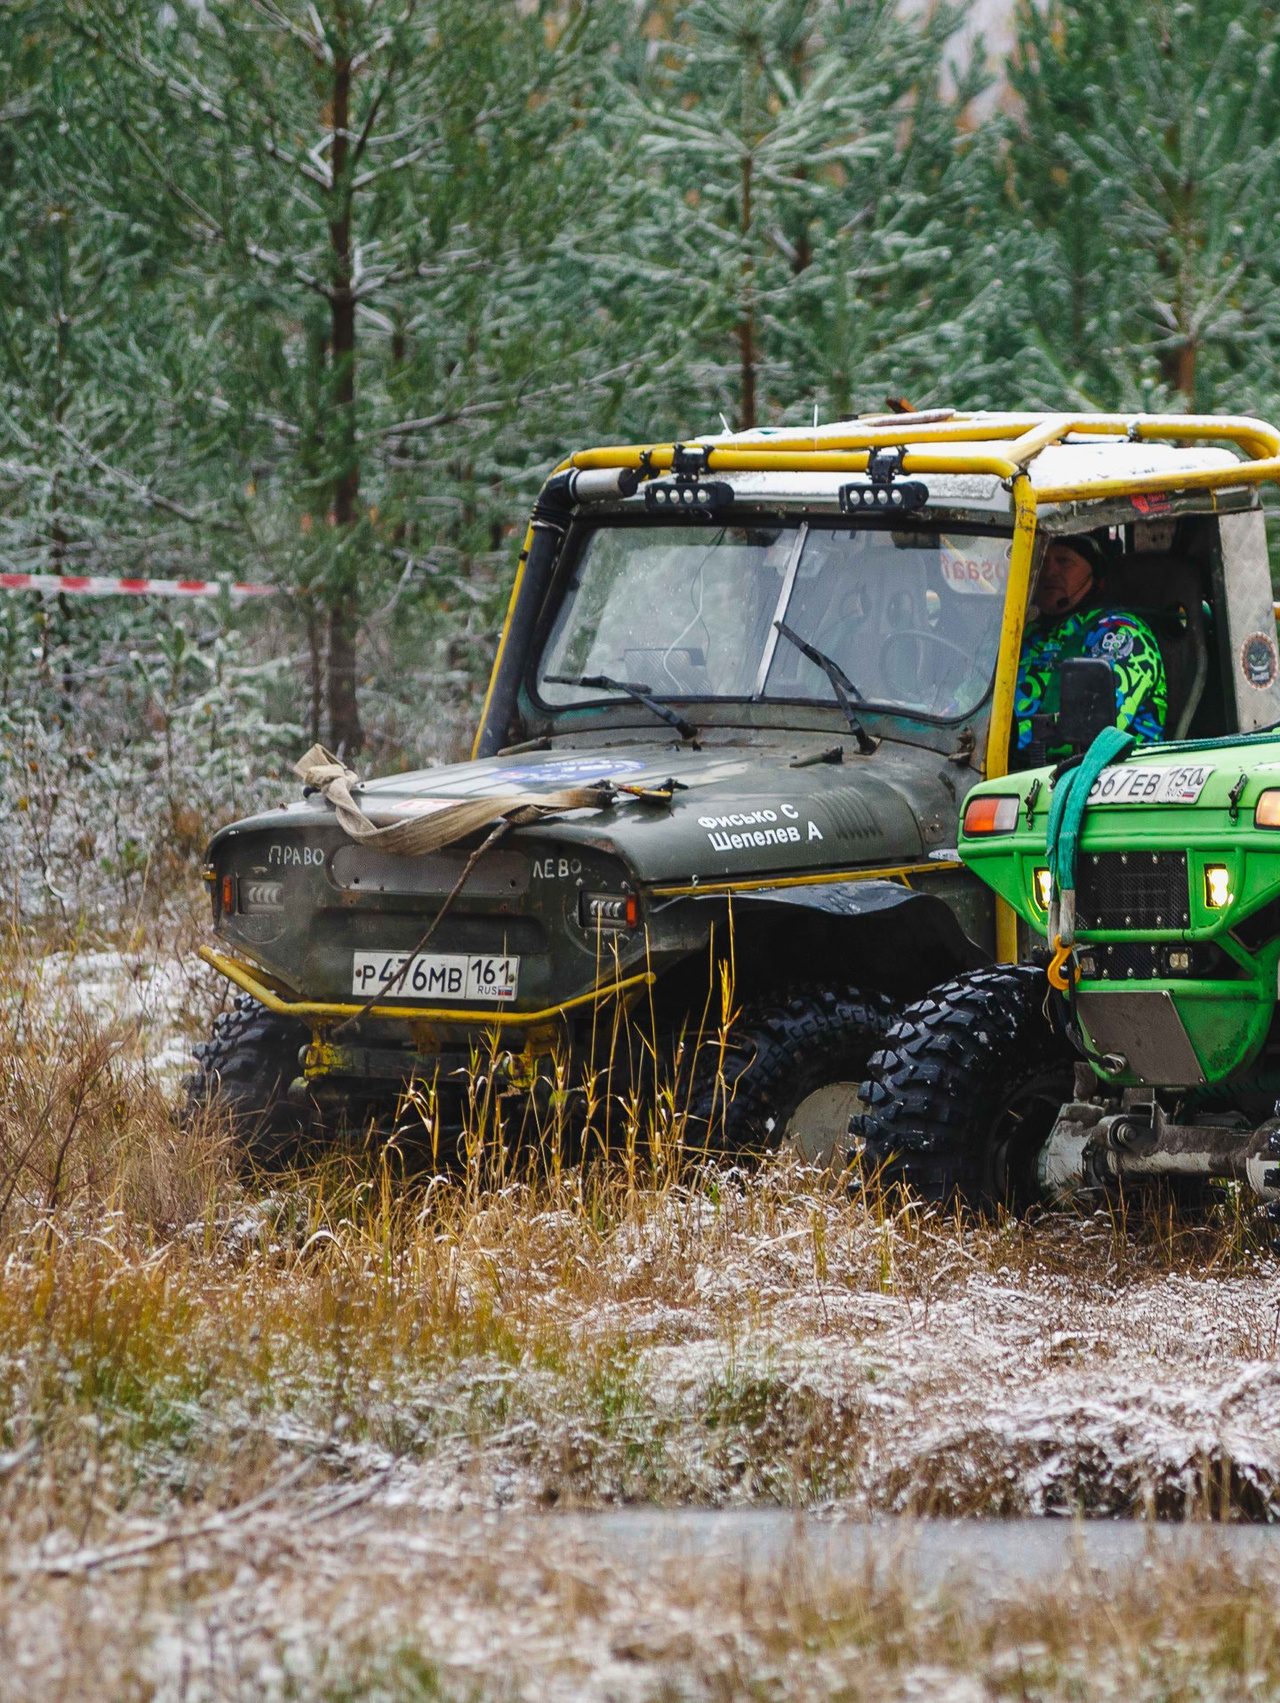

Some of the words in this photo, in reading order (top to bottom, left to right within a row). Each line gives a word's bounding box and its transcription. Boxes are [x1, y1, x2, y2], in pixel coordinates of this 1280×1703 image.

[698, 810, 778, 829] Фисько
[707, 826, 801, 851] Шепелев
[807, 821, 823, 841] А
[268, 845, 325, 866] ПРАВО
[533, 858, 582, 879] ЛЕВО
[471, 959, 510, 985] 161
[477, 986, 498, 995] RUS
